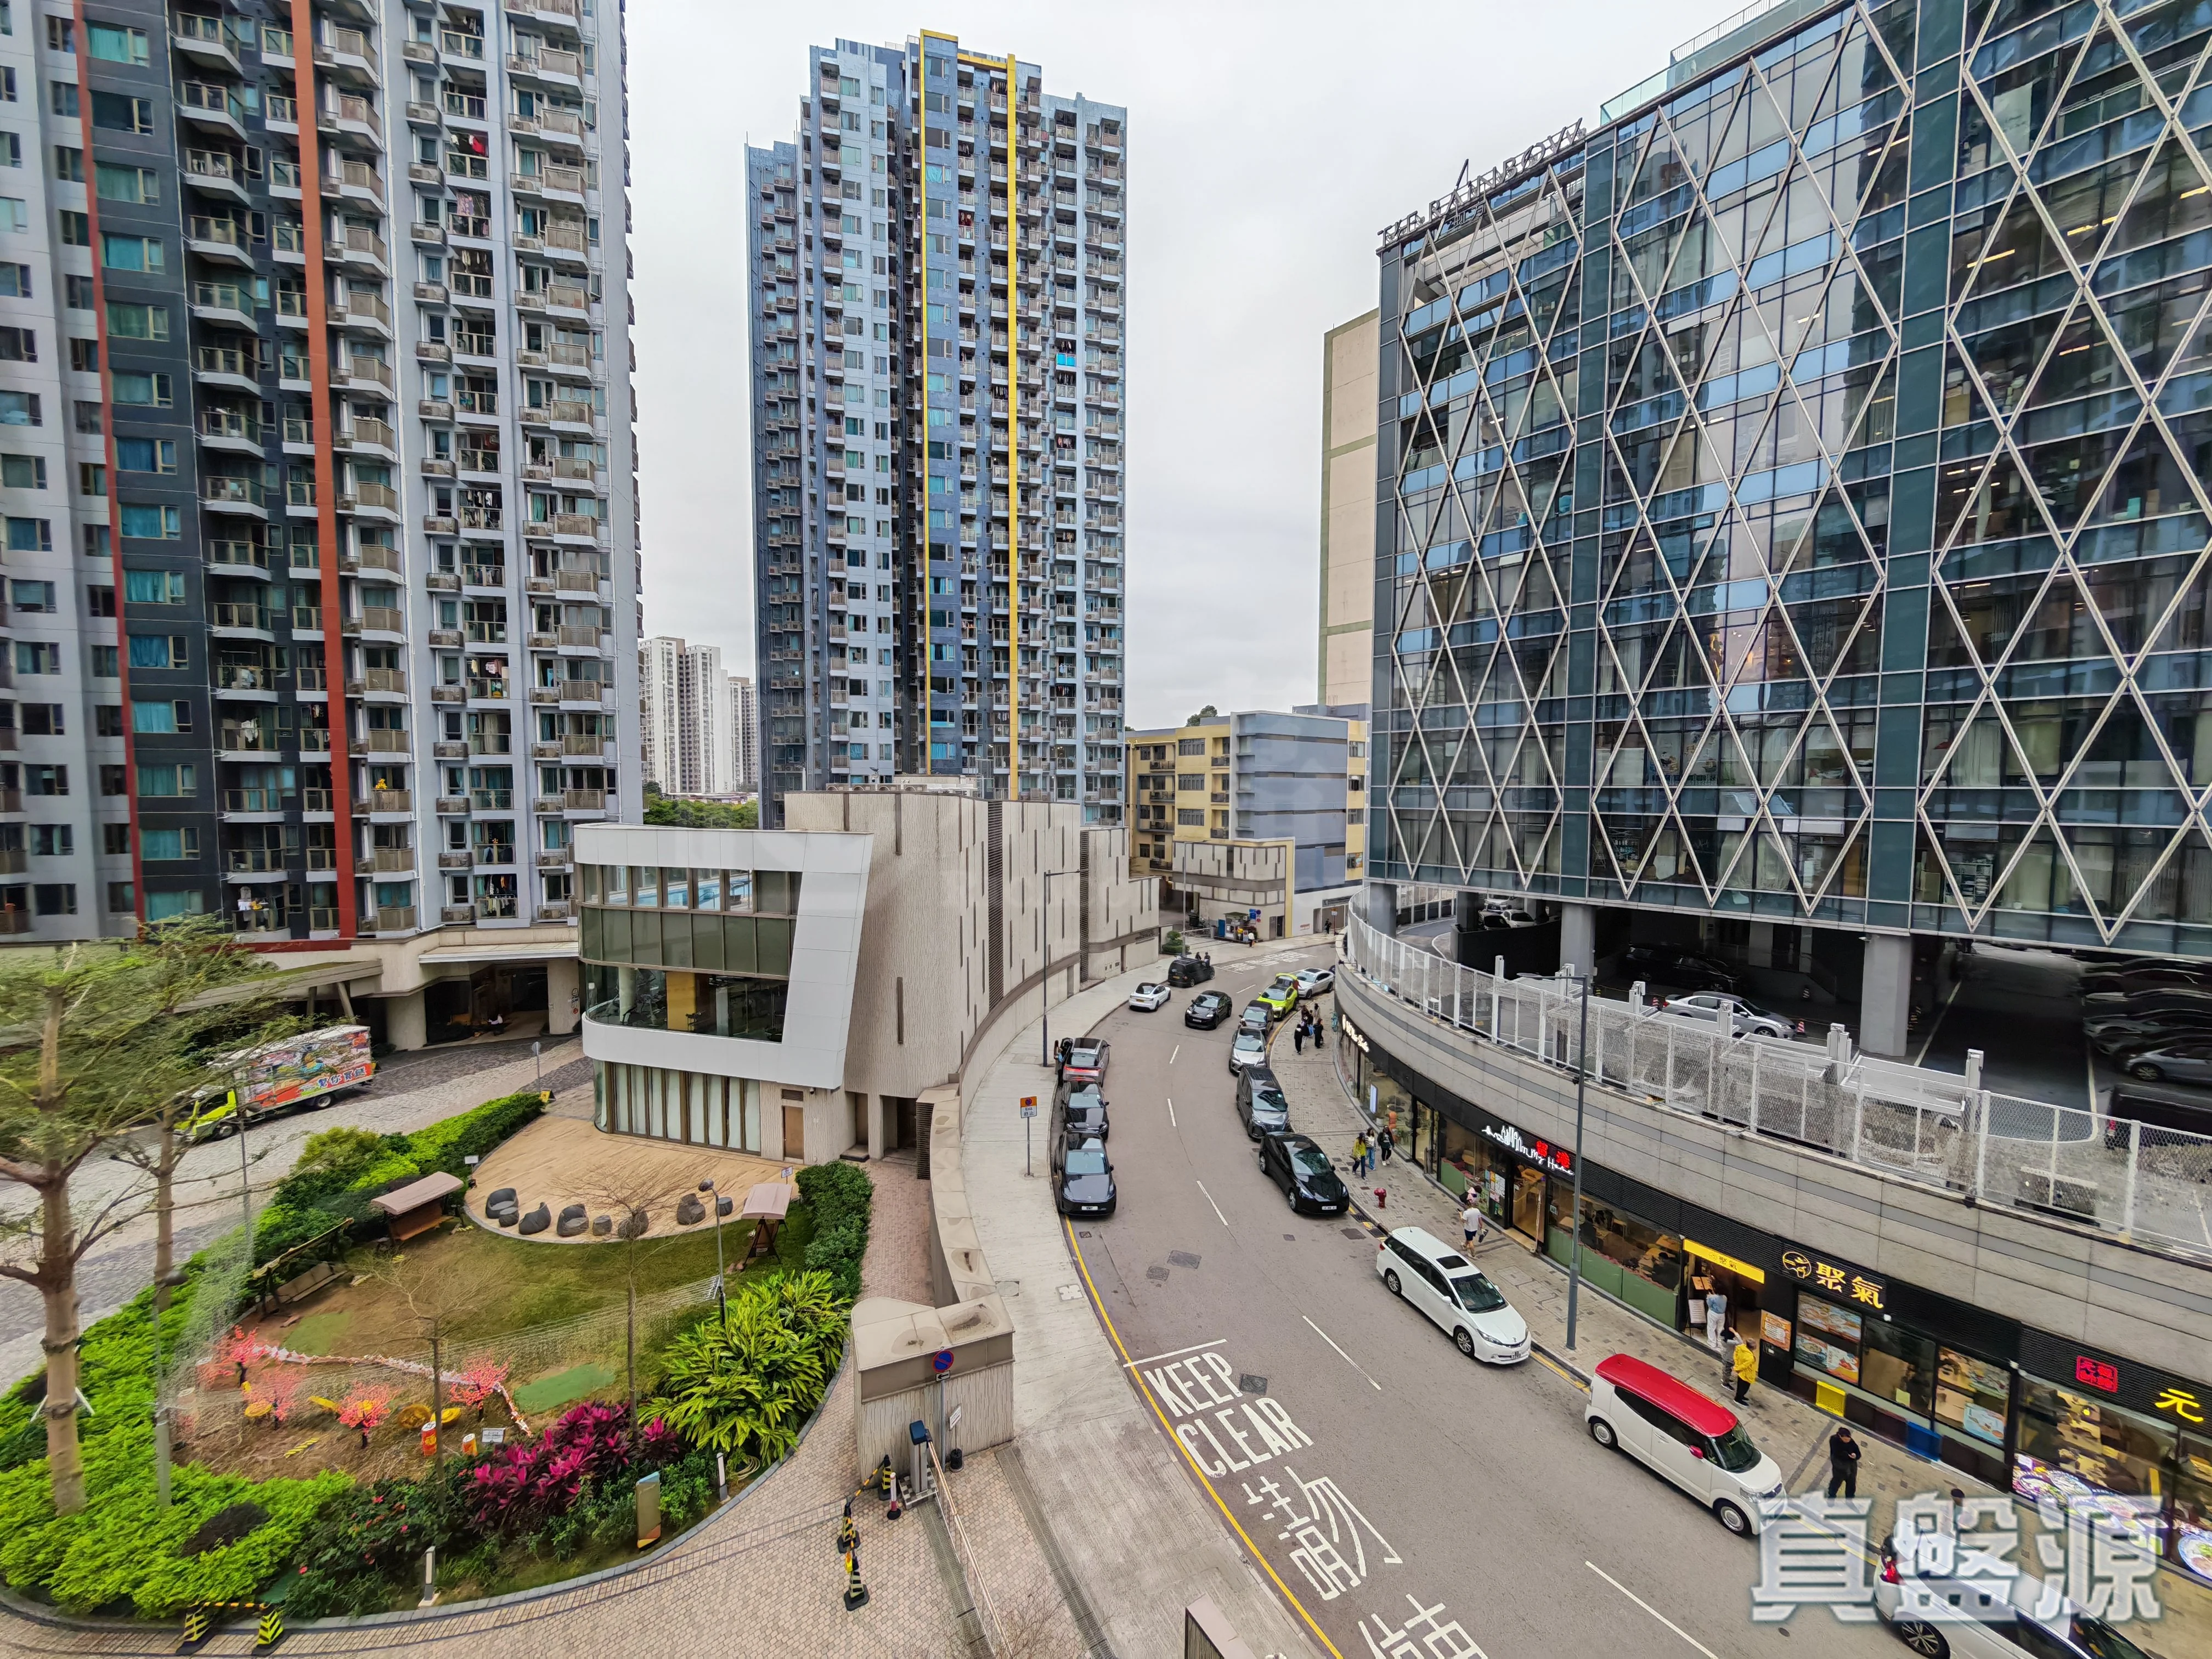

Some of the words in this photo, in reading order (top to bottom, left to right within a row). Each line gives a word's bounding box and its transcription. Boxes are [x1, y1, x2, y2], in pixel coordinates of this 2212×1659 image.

[1377, 210, 1418, 247] THE
[1429, 117, 1584, 218] RAINBOW
[1815, 1260, 1885, 1309] 聚氣
[1144, 1352, 1244, 1417] KEEP
[2154, 1387, 2205, 1423] 元
[1175, 1397, 1313, 1479] CLEAR
[1242, 1466, 1402, 1600] 請勿
